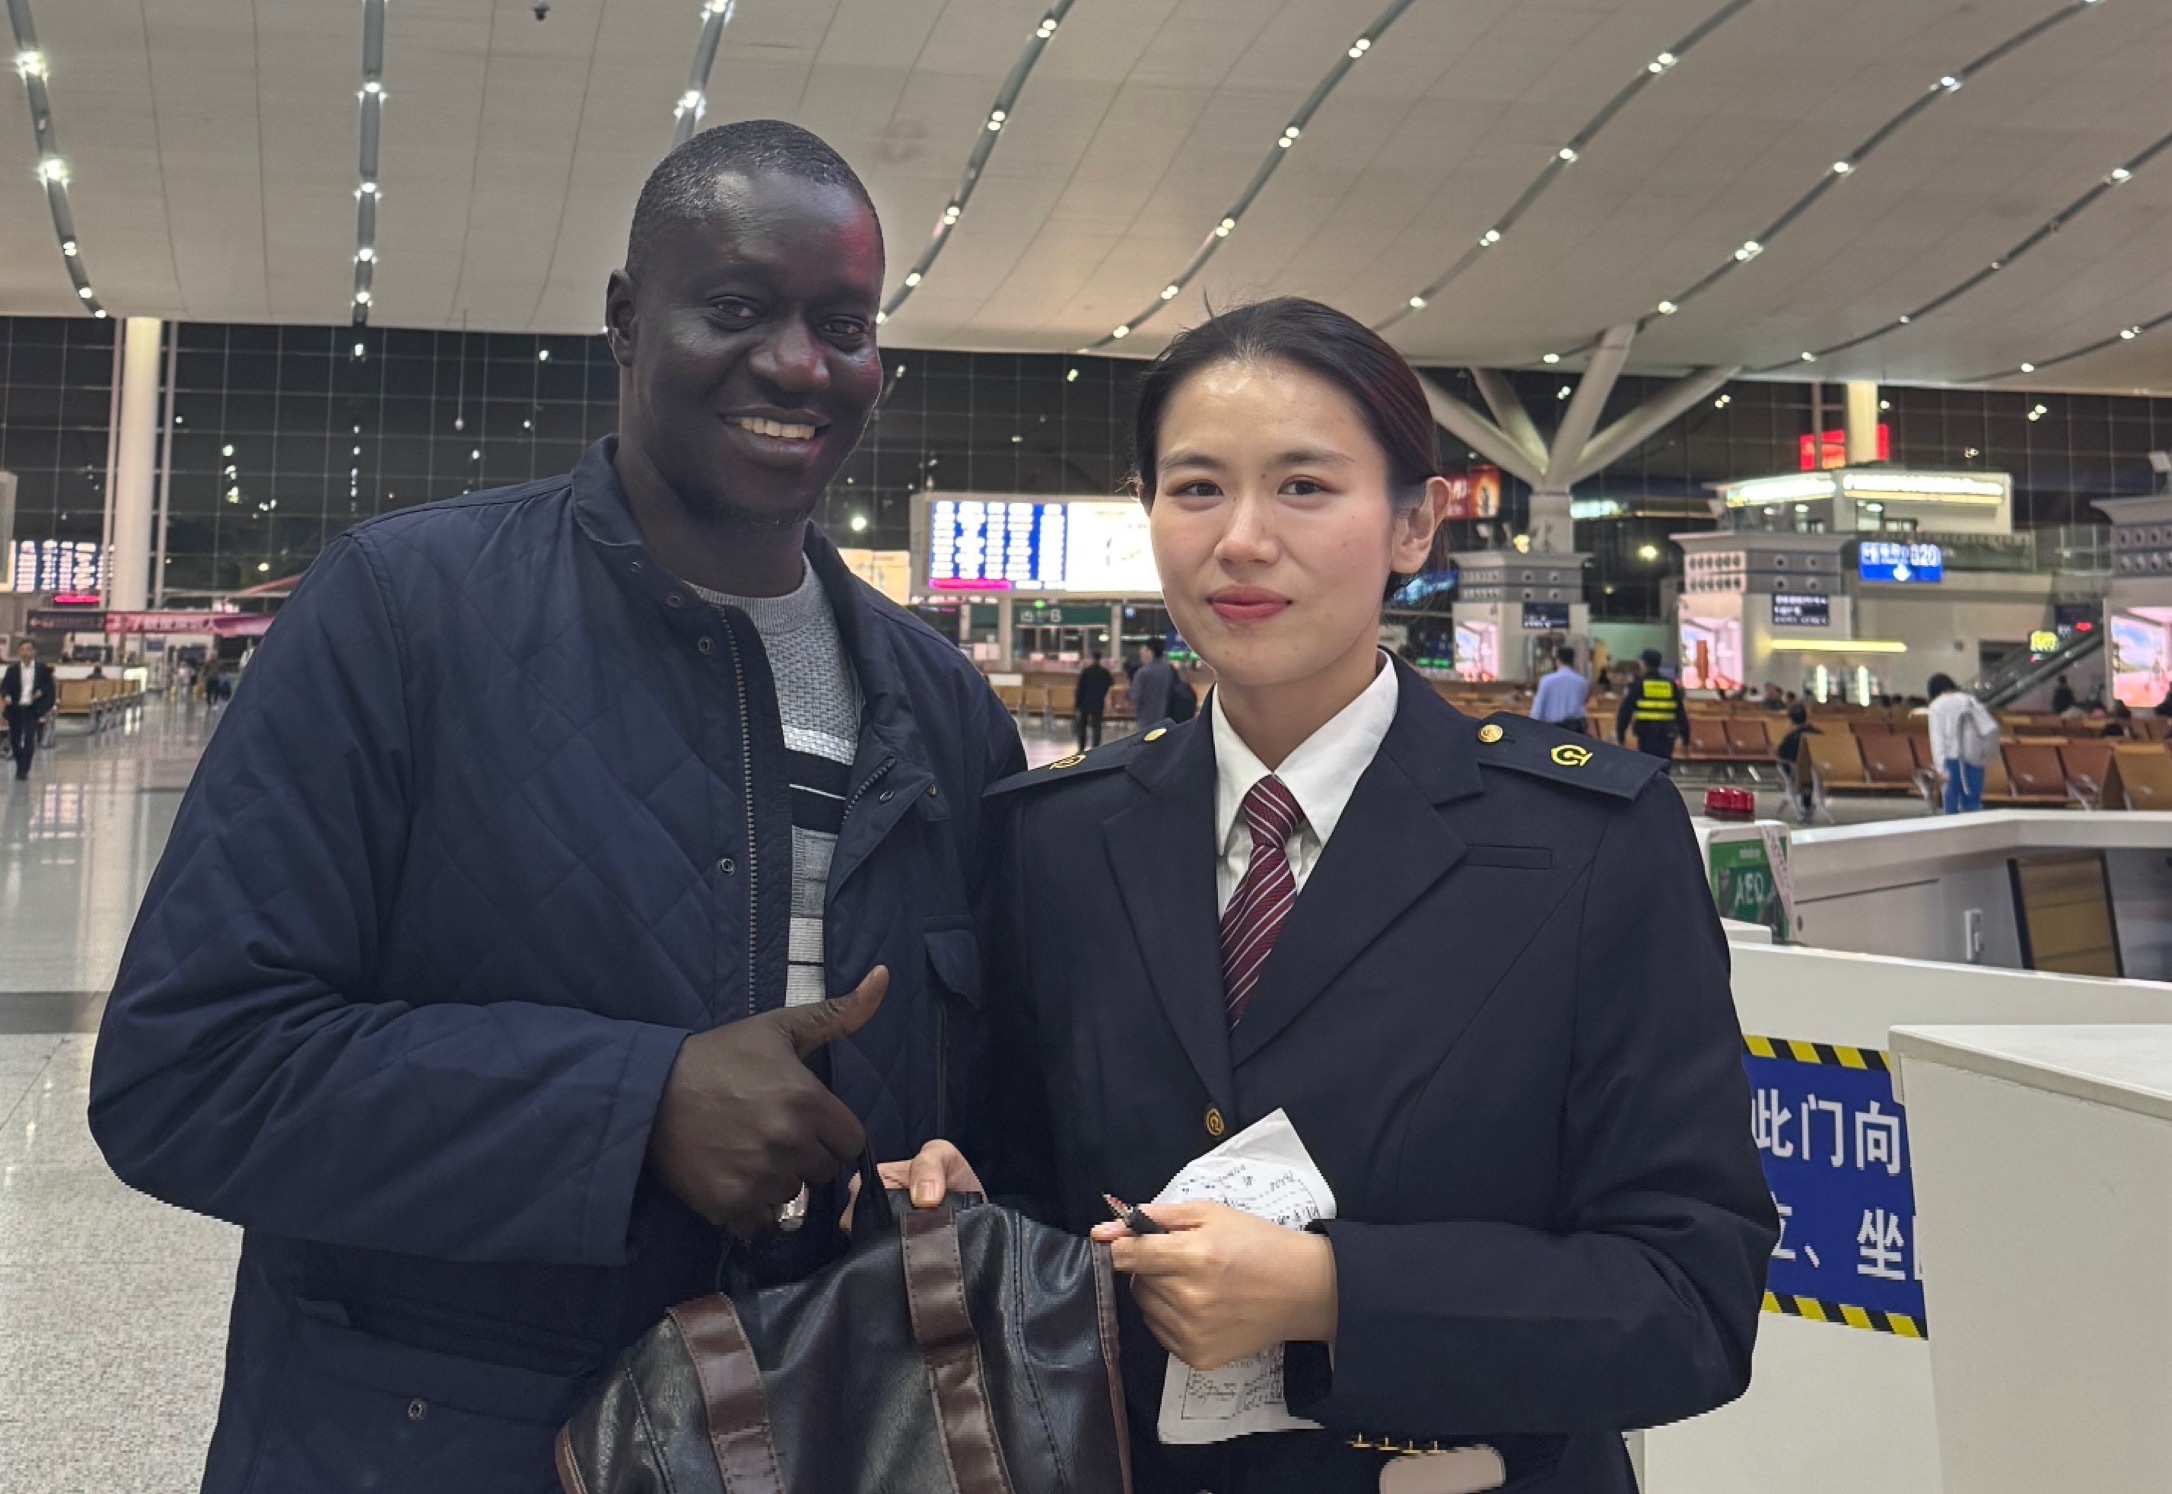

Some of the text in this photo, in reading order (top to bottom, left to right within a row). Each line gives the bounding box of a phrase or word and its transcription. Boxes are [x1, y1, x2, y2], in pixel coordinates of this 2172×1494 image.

[1734, 872, 1764, 908] AED
[1752, 1089, 1900, 1175] 此门向
